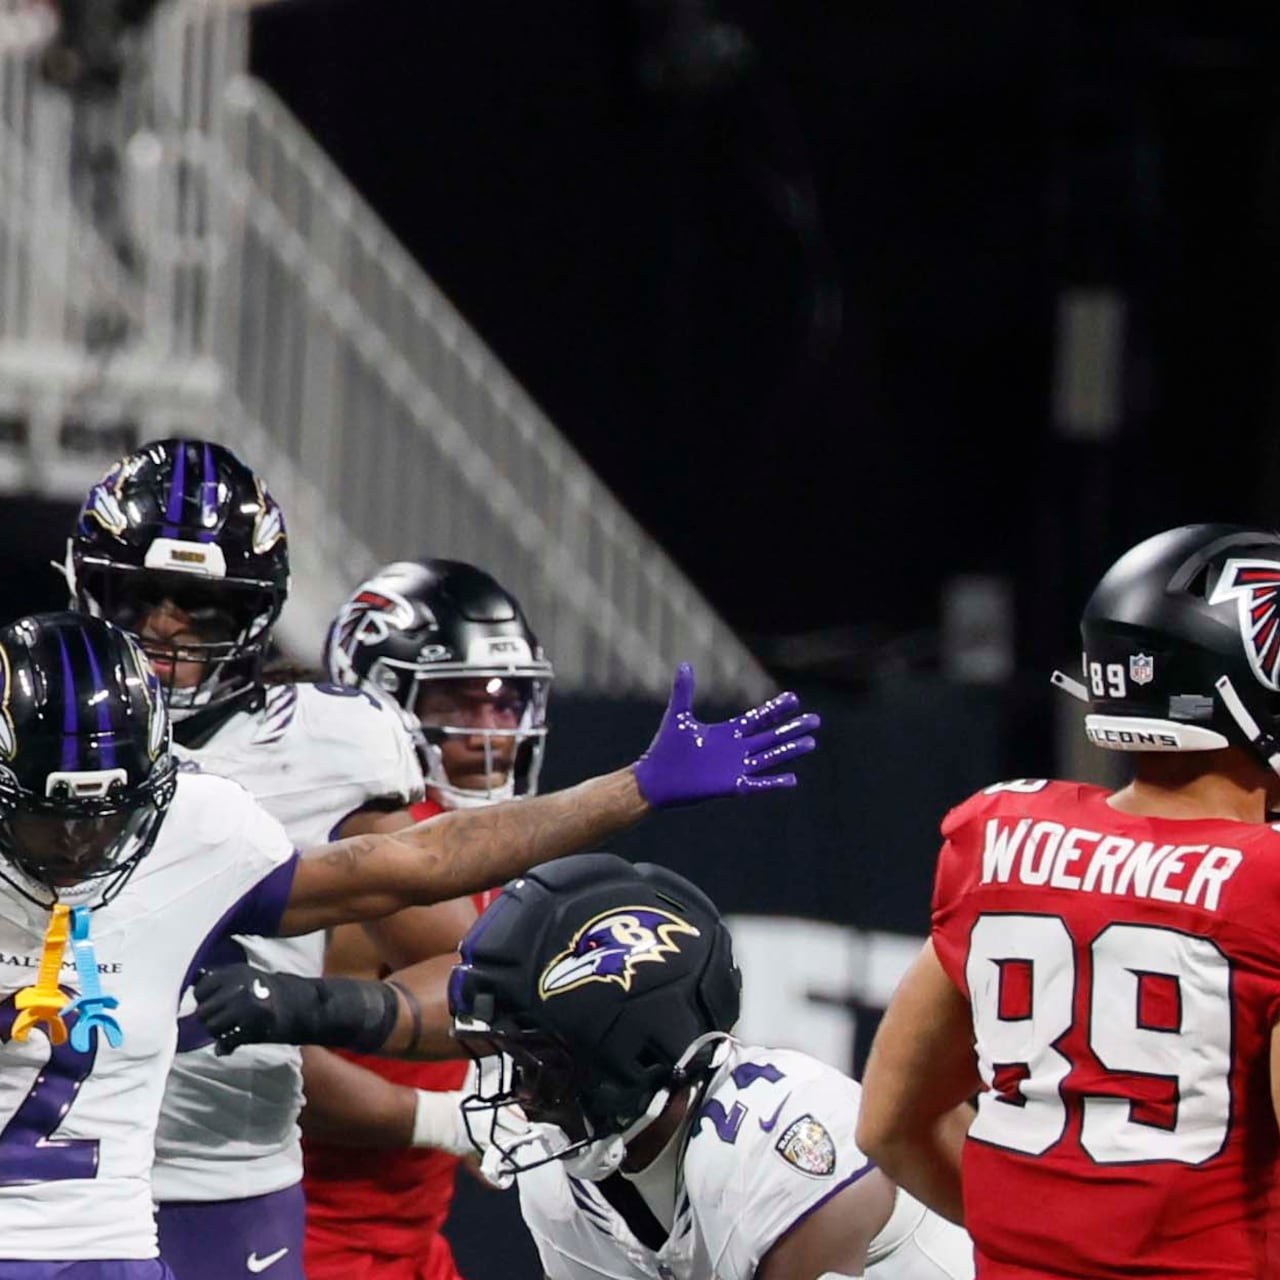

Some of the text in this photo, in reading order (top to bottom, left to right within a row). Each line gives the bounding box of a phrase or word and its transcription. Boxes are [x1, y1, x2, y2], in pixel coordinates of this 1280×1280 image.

[1089, 661, 1127, 699] 89
[981, 818, 1243, 912] WOERNER
[964, 911, 1234, 1167] 89
